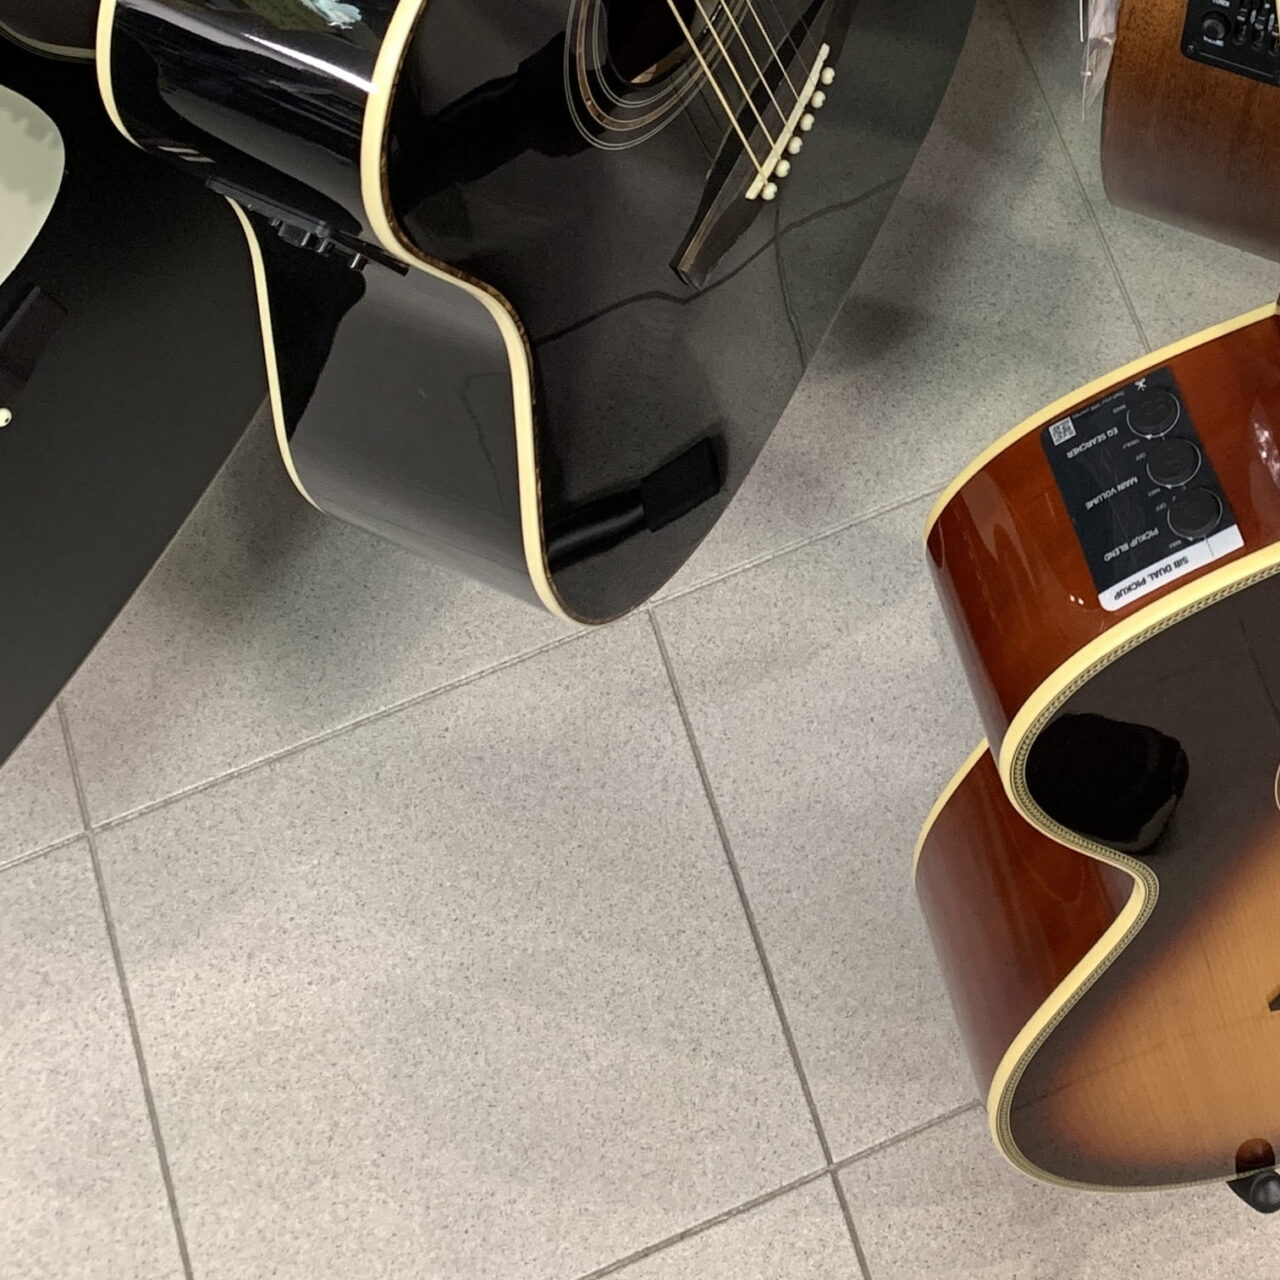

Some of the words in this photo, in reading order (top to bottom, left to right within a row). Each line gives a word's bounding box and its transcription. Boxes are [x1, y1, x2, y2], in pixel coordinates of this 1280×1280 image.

[1066, 432, 1107, 459] SEARCHER
[1117, 476, 1138, 491] MAIN
[1085, 487, 1117, 510] VOLUME
[1130, 527, 1159, 548] PICKUP
[1147, 564, 1173, 581] DUAL
[1114, 578, 1147, 600] PICKUP
